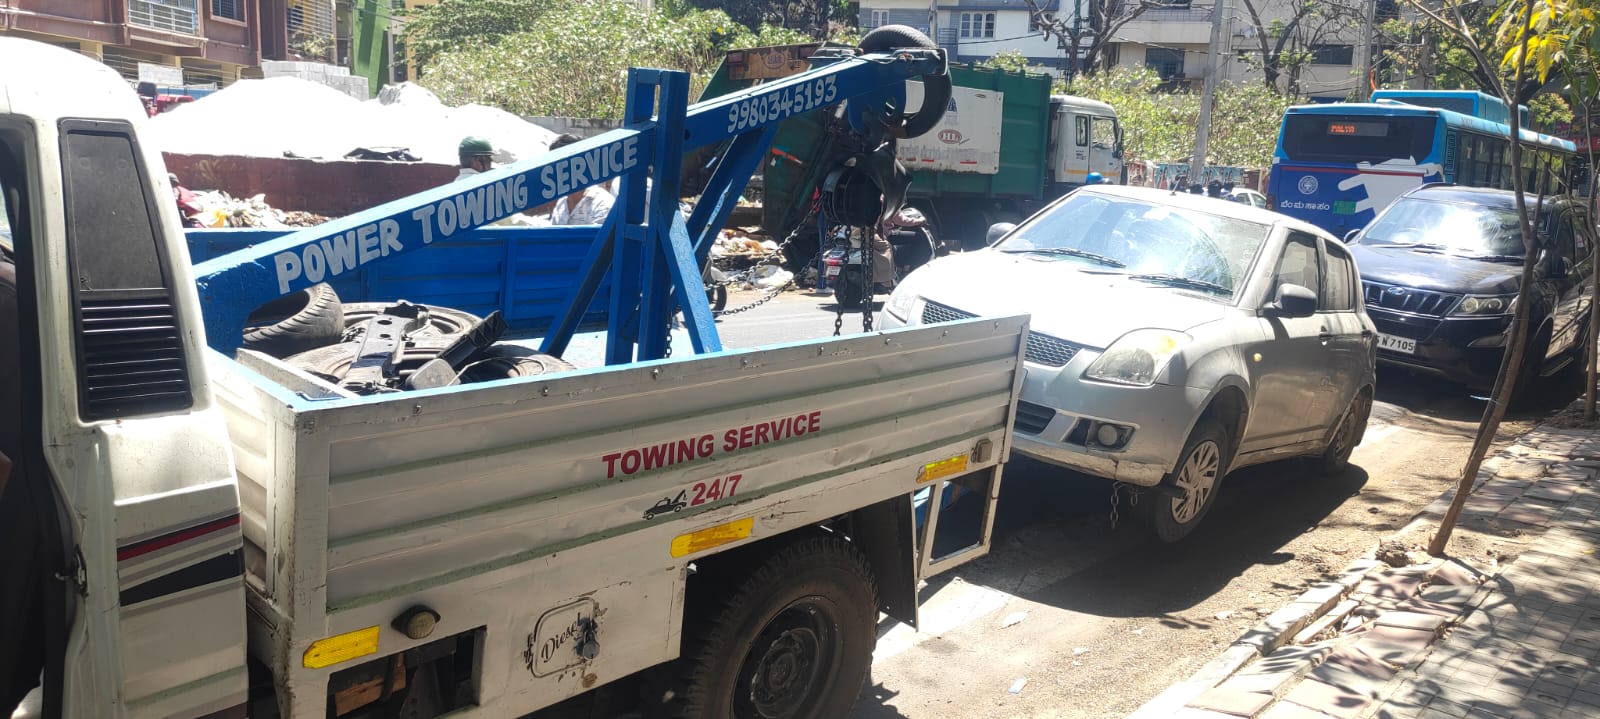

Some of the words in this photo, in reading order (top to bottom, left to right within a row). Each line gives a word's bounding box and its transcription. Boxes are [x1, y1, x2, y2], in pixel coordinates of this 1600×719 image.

[728, 75, 837, 133] 9980345193
[274, 219, 403, 295] POWER
[412, 174, 528, 244] TOWING
[541, 136, 639, 199] SERVICE
[602, 434, 715, 479] TOWING
[723, 411, 821, 452] SERVICE
[691, 474, 743, 507] 24/7
